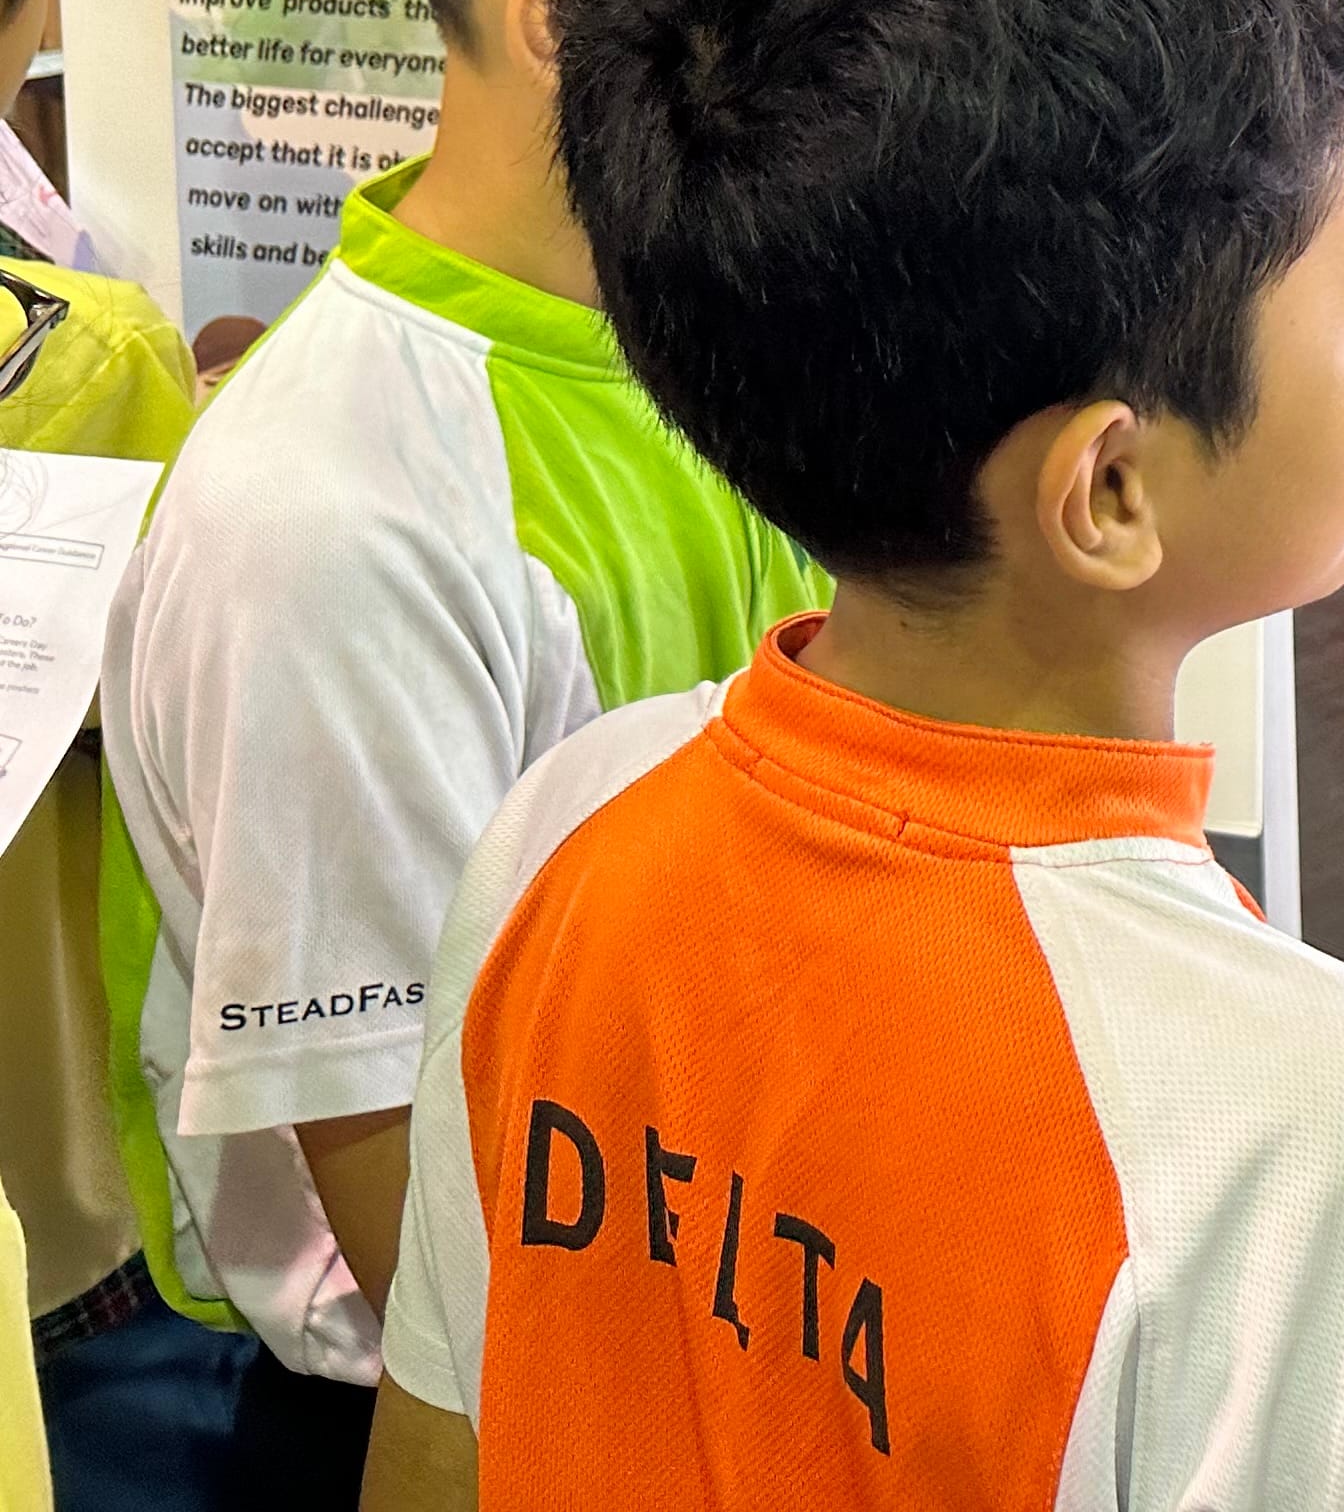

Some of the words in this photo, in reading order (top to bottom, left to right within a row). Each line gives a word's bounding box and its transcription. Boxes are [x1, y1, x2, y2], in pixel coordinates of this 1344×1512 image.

[181, 33, 253, 59] better
[257, 37, 295, 63] life
[300, 41, 331, 65] for
[184, 82, 226, 108] The
[230, 87, 319, 117] biggest
[324, 94, 440, 130] challenge
[185, 137, 264, 166] accept
[271, 141, 323, 168] that
[328, 143, 345, 168] it
[351, 145, 372, 171] is
[187, 185, 251, 211] move
[258, 191, 288, 214] on
[191, 234, 247, 260] skills
[253, 238, 298, 265] and
[520, 1098, 892, 1457] DELTA
